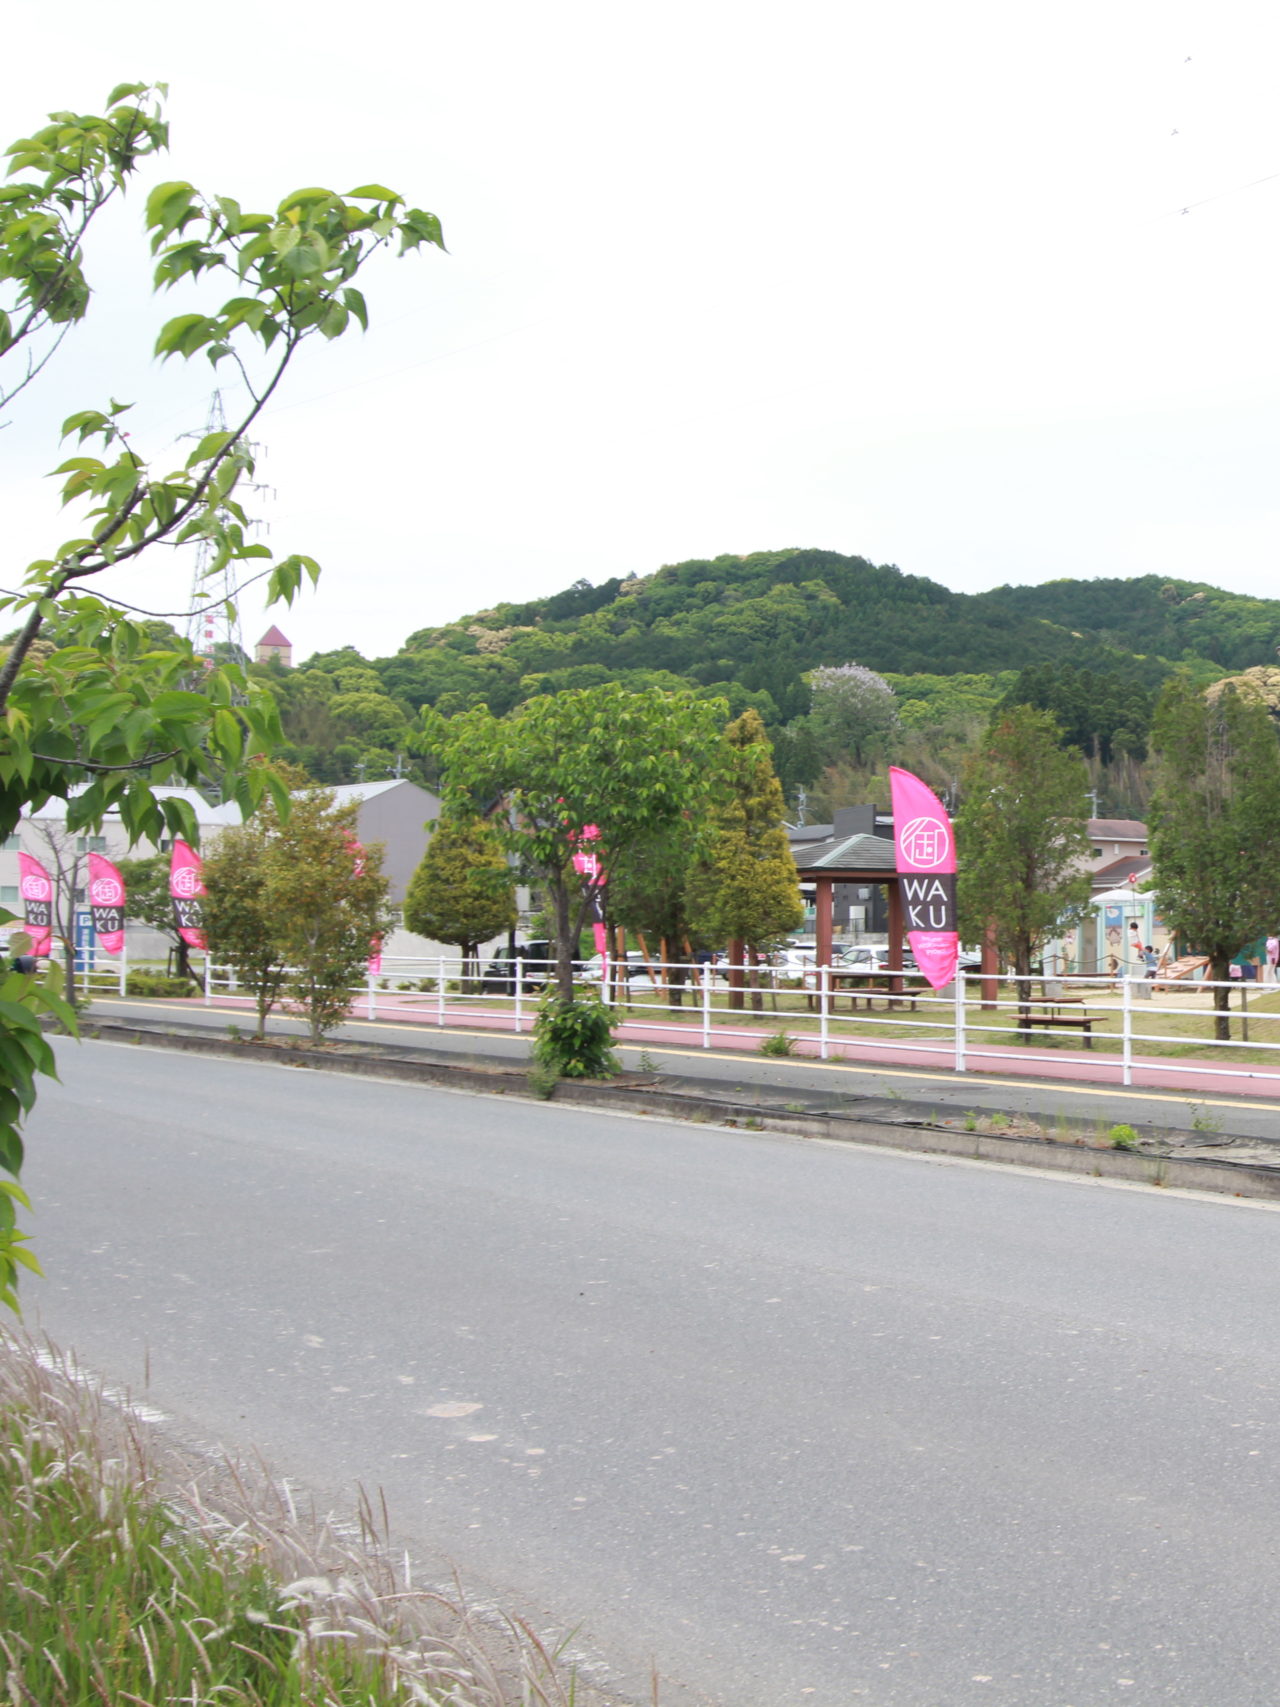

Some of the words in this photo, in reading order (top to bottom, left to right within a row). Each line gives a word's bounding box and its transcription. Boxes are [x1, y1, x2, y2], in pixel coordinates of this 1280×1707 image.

[904, 879, 948, 902] WA
[26, 901, 48, 914] WA
[93, 907, 120, 920] WA
[28, 913, 48, 926] KU
[82, 916, 90, 925] P
[908, 905, 946, 929] KU
[95, 920, 119, 932] KU
